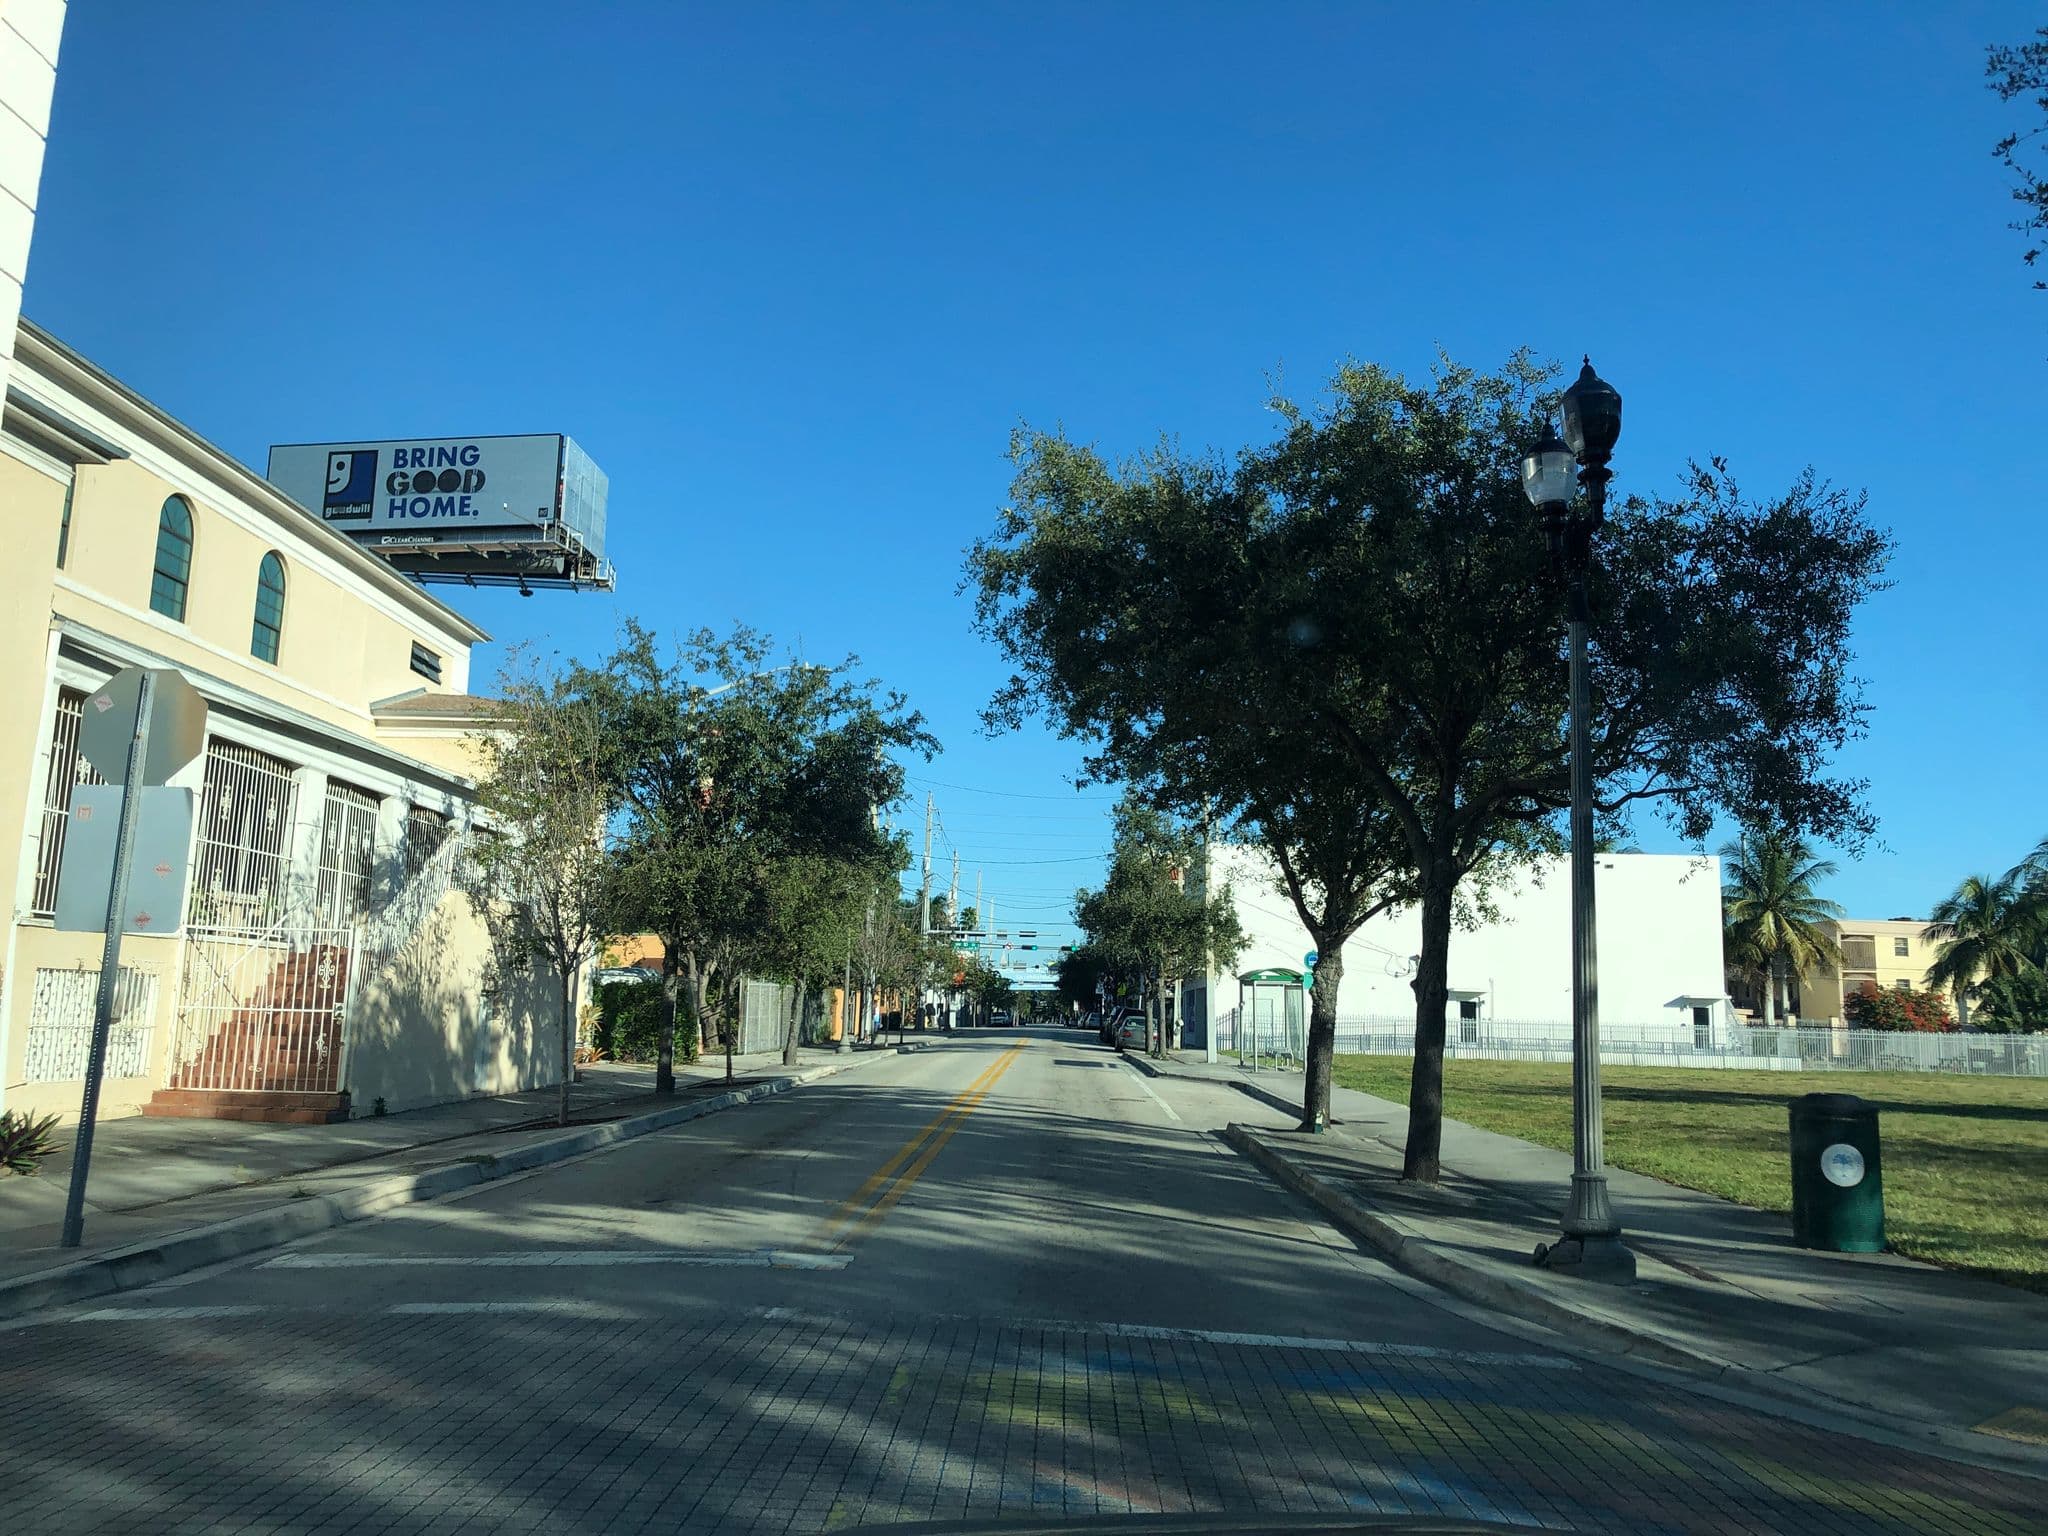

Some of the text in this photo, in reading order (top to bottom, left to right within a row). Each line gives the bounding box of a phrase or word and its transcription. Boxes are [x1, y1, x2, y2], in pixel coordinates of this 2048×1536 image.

[393, 445, 481, 468] BRING
[386, 468, 486, 496] GOOD
[388, 496, 479, 518] HOME.
